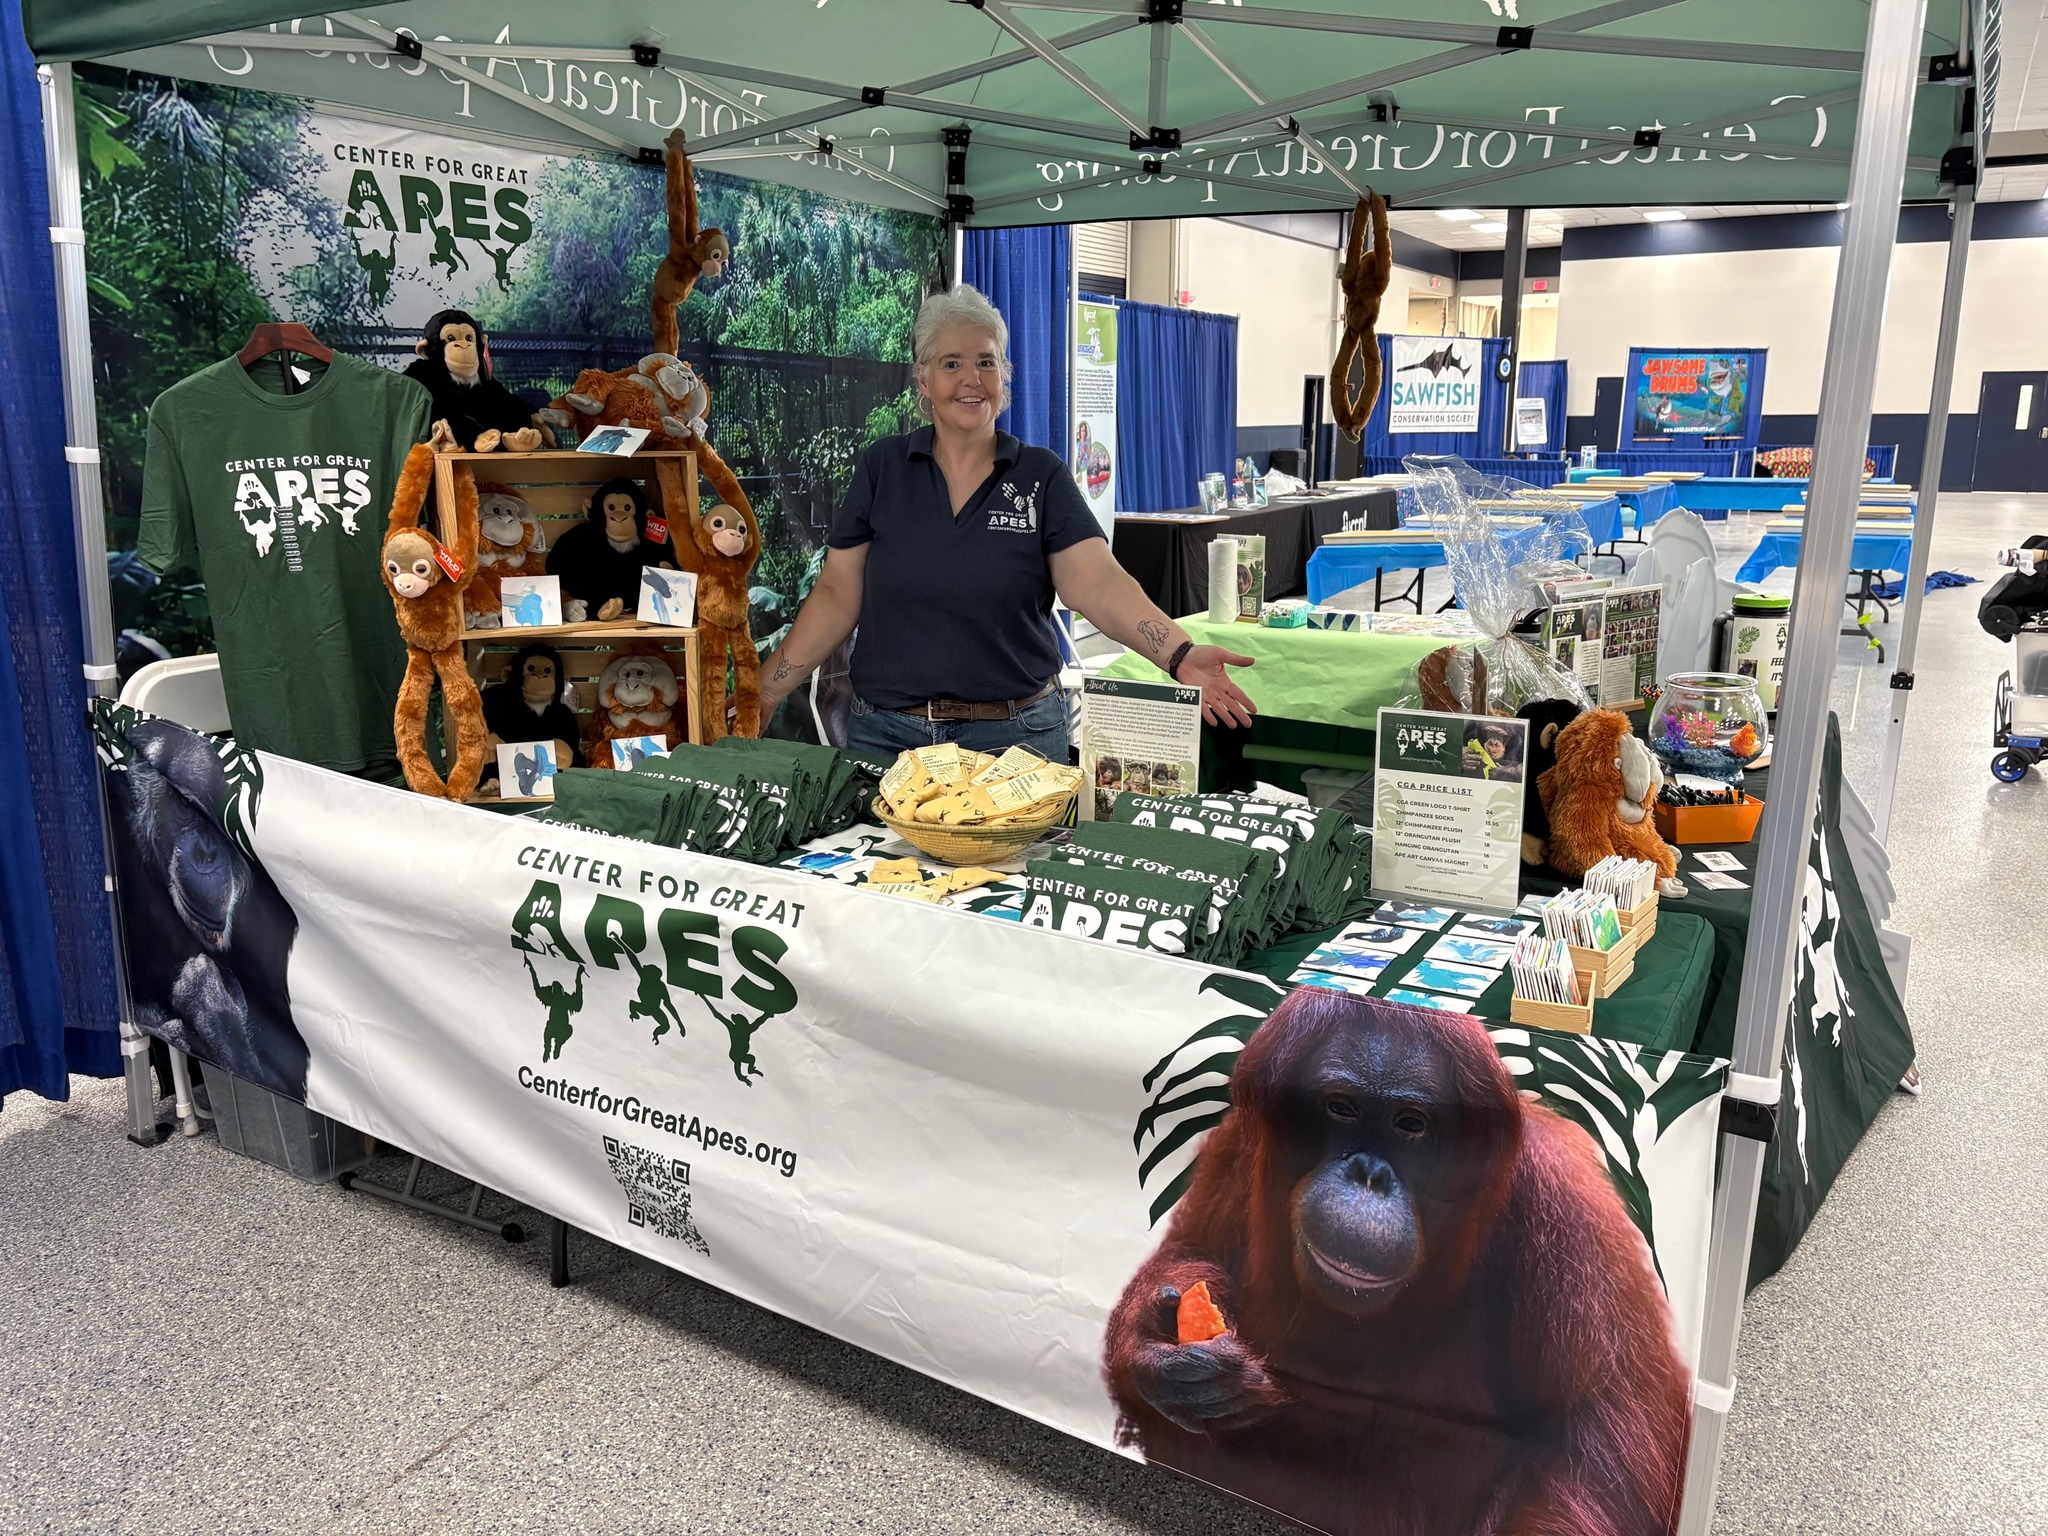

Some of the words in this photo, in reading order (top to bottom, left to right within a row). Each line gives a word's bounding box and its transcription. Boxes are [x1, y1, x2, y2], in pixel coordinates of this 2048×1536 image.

[334, 144, 415, 169] CENTER
[425, 156, 463, 176] FOR
[472, 163, 528, 184] GREAT
[343, 169, 533, 245] APES
[1643, 358, 1707, 375] JAWSOME
[1650, 375, 1698, 394] DRUMS
[1393, 382, 1475, 406] SAWFISH
[1393, 415, 1445, 423] CONSERVATION
[1447, 415, 1474, 423] SOCIETY
[225, 457, 286, 473] CENTER
[293, 455, 321, 466] FOR
[326, 455, 371, 470] GREAT
[234, 468, 372, 512] APES
[647, 520, 666, 532] WILD
[988, 515, 1027, 529] APES
[440, 549, 460, 572] WILD
[1556, 613, 1576, 625] APES
[1085, 679, 1106, 692] About
[1107, 682, 1119, 692] Us
[1175, 688, 1196, 698] APES
[1396, 728, 1447, 745] APES
[755, 780, 790, 798] REAT
[1397, 781, 1416, 789] CGA
[1420, 784, 1448, 793] PRICE
[1452, 787, 1473, 796] LIST
[1131, 798, 1192, 816] CENTER
[1199, 809, 1233, 825] FOR
[1238, 816, 1294, 838] GREAT
[1396, 810, 1434, 819] CHIMPANZEE
[1404, 822, 1442, 831] CHIMPANZEE
[1404, 832, 1440, 841] ORANGUTAN
[1395, 842, 1421, 850] HANGING
[1423, 845, 1459, 854] ORANGUTAN
[1056, 845, 1125, 865] CENTER
[1131, 858, 1169, 875] FOR
[517, 846, 622, 888] CENTER
[639, 870, 700, 903] FOR
[710, 887, 806, 928] GREAT
[1026, 876, 1086, 900] CENTER
[1093, 889, 1129, 908] FOR
[1135, 896, 1195, 918] GREAT
[510, 879, 799, 1015] APES
[518, 1065, 798, 1178] CenterforGreatApes.org
